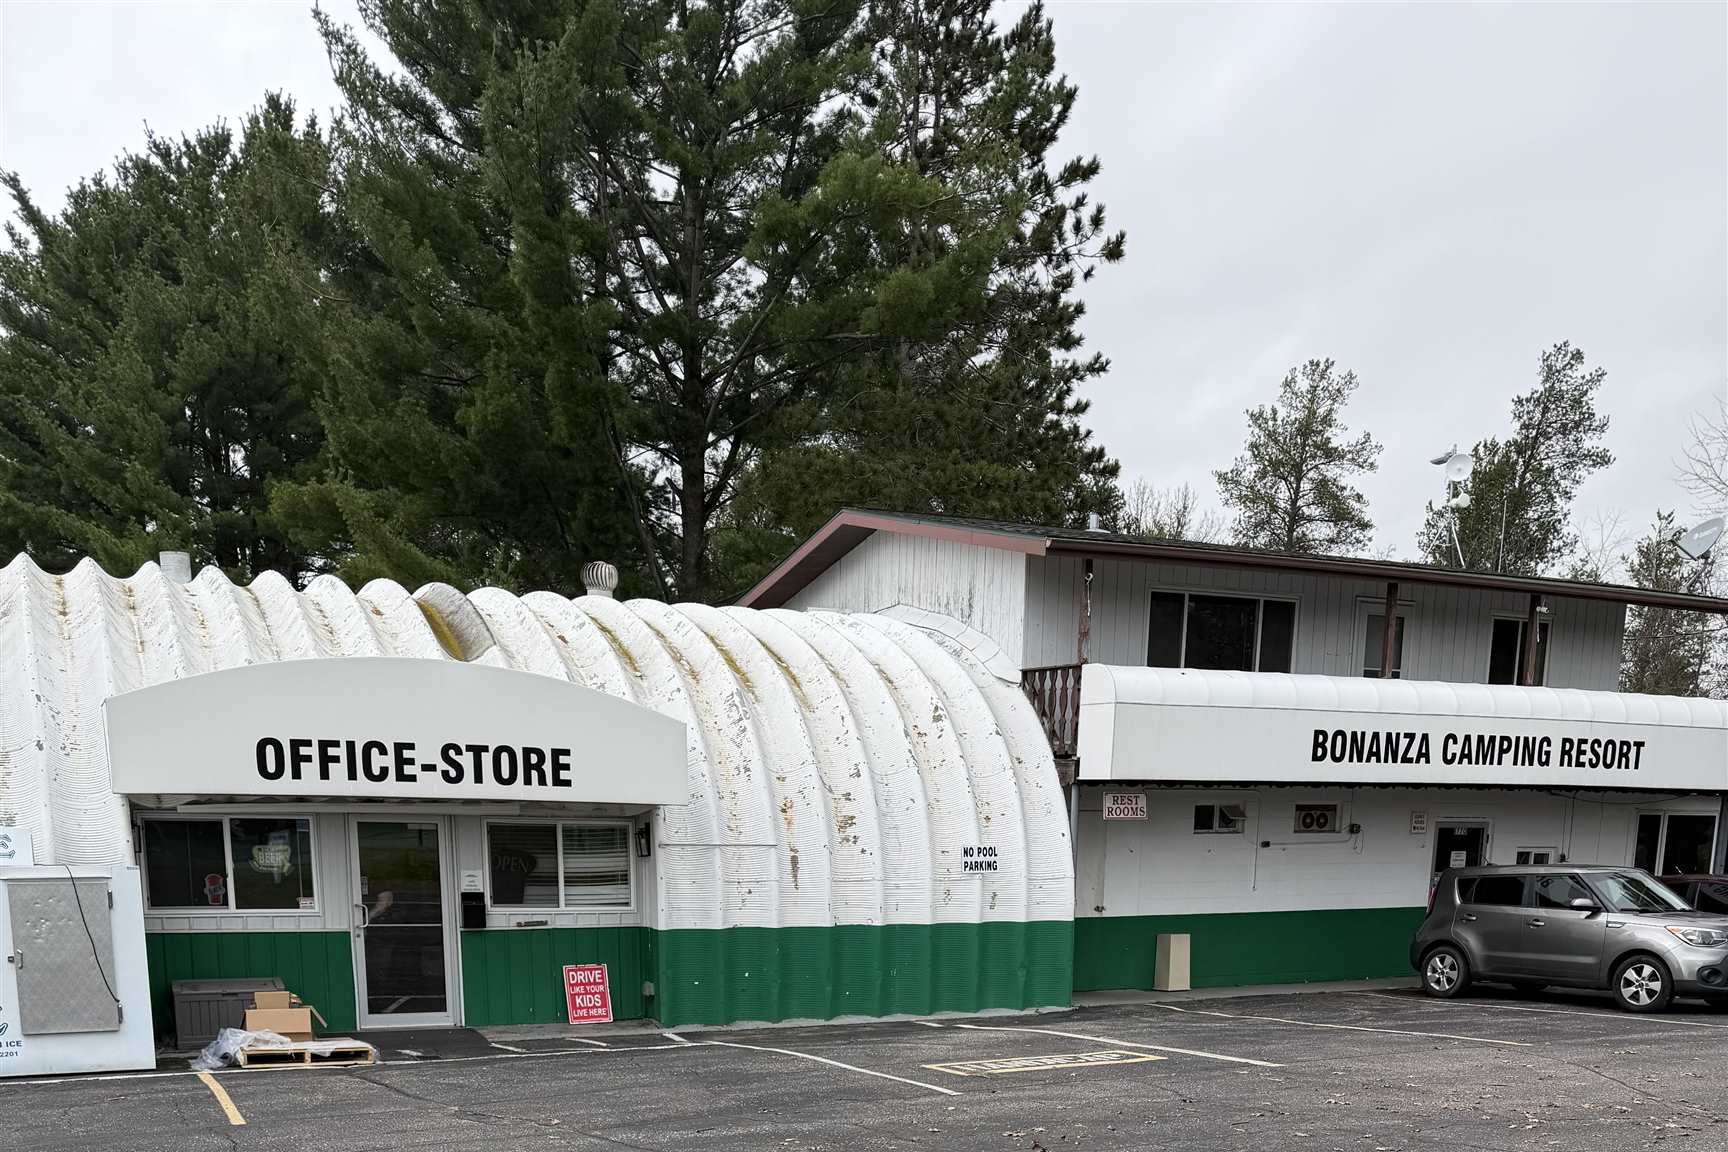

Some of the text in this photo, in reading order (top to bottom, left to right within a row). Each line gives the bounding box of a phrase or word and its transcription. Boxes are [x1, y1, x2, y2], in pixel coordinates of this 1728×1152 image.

[1312, 729, 1645, 770] BONANZA CAMPING RESORT
[256, 737, 572, 787] OFFICE-STORE
[1112, 795, 1140, 806] REST
[1107, 806, 1146, 817] ROOMS
[963, 846, 998, 857] NO POOL
[963, 860, 998, 872] PARKING
[569, 970, 603, 984] DRIVE
[570, 985, 605, 994] LIKE YOUR
[575, 994, 602, 1008] KIDS
[573, 1008, 607, 1017] LIVE HERE
